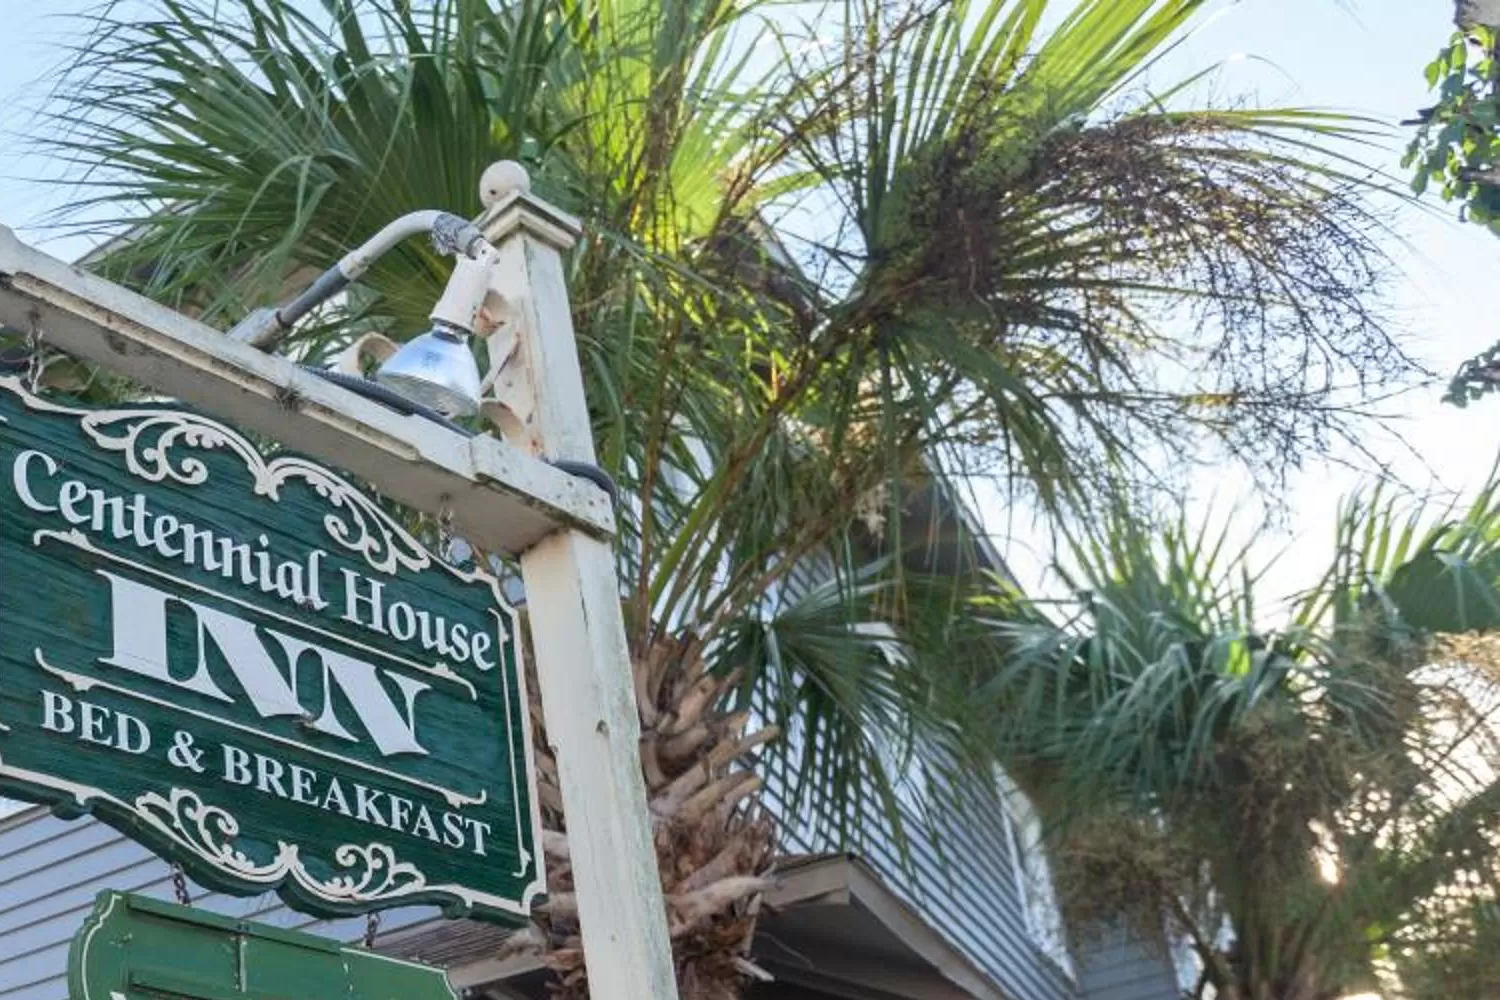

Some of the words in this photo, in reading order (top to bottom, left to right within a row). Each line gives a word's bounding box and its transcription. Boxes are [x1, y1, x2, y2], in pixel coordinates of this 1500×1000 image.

[12, 449, 329, 611] Centennial
[340, 567, 496, 672] House
[96, 569, 432, 757] INN
[41, 689, 152, 755] BED
[167, 730, 206, 773] &
[222, 744, 492, 856] BREAKFAST
